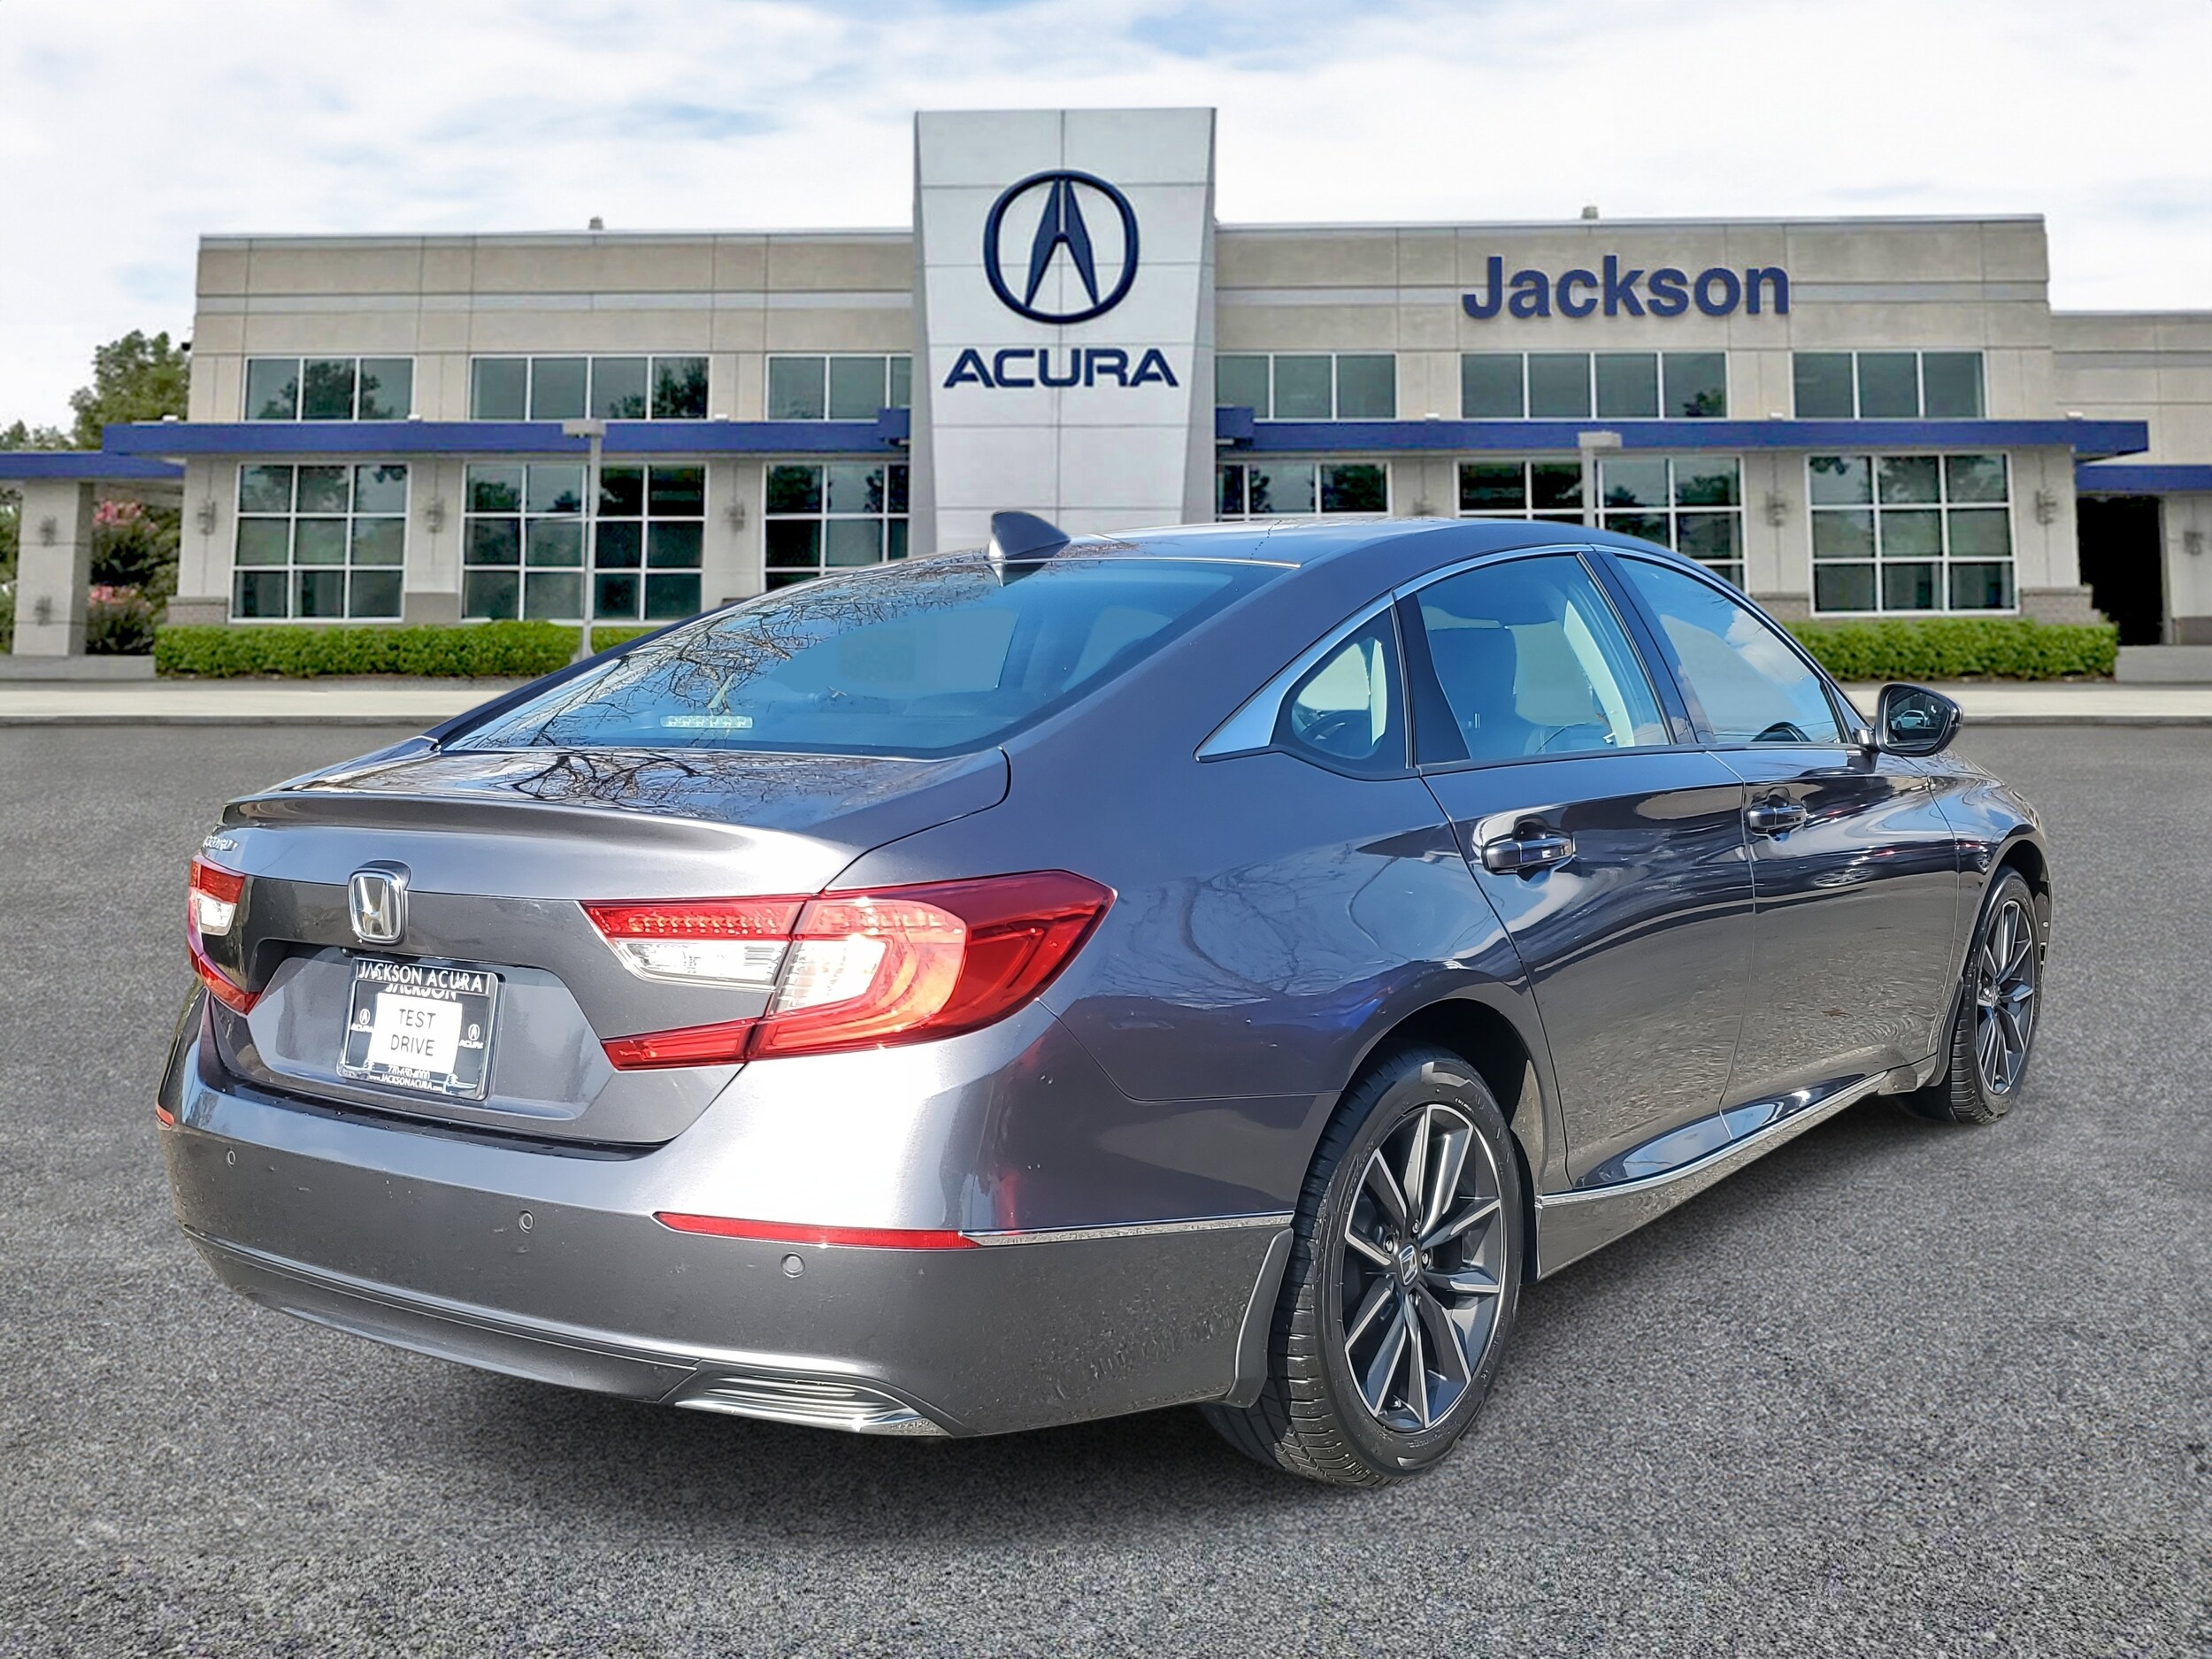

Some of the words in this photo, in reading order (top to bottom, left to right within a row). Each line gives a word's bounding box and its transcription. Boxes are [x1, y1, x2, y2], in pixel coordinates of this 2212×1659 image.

[1462, 255, 1789, 319] Jackson
[943, 348, 1179, 388] ACURA
[358, 961, 422, 982] JACKSON
[426, 969, 483, 993] ACURA
[399, 1009, 437, 1029] TEST
[390, 1033, 436, 1056] DRIVE
